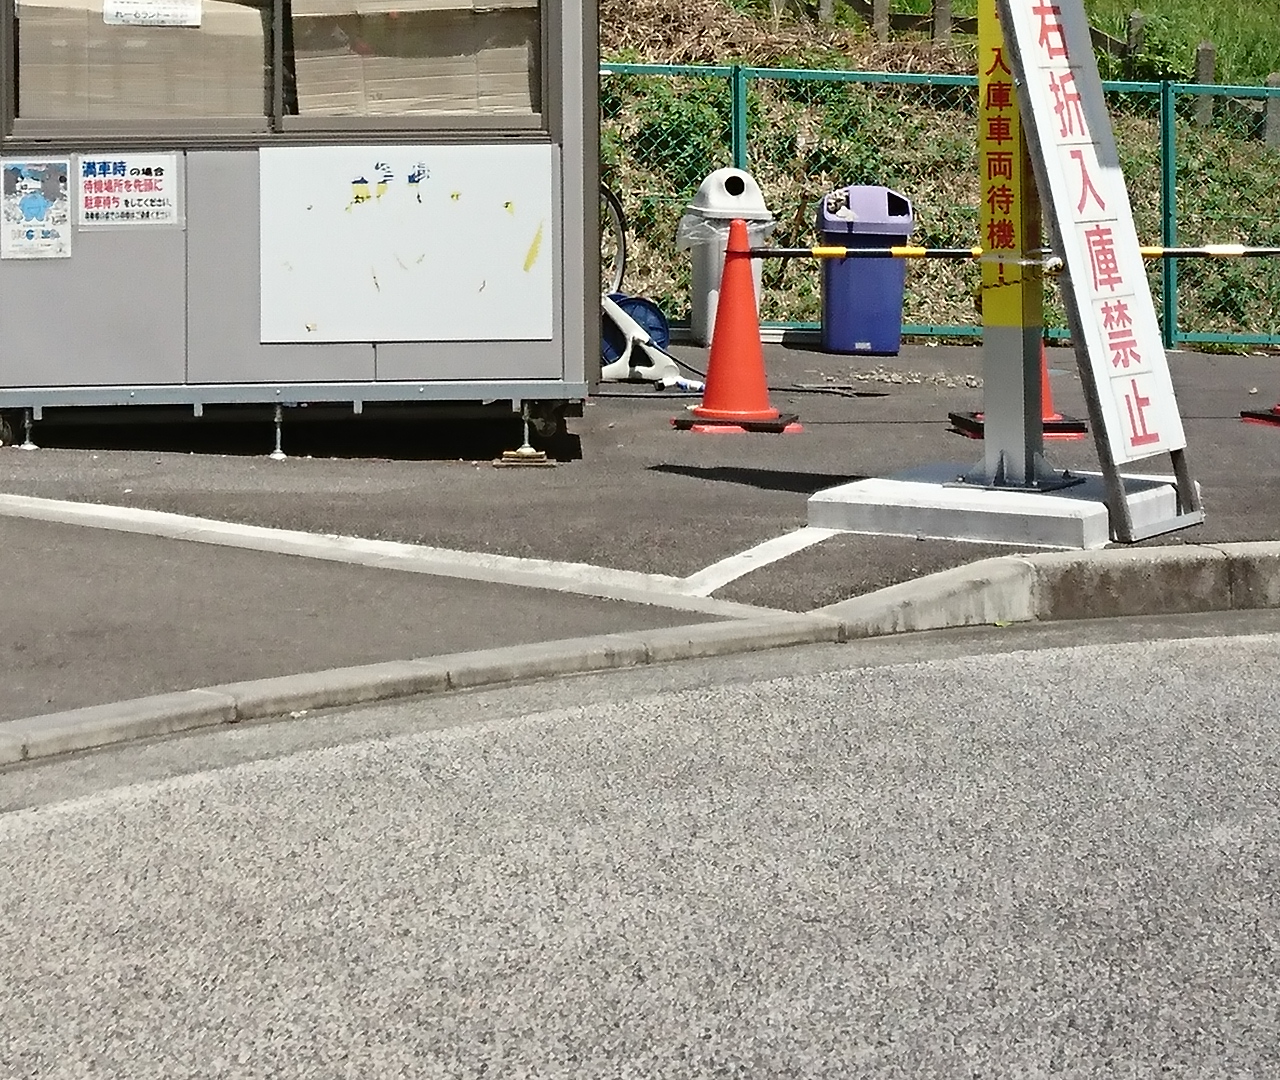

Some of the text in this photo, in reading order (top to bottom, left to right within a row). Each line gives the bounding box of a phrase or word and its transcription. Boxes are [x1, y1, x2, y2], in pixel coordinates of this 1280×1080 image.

[82, 160, 165, 177] 満車時 の場合
